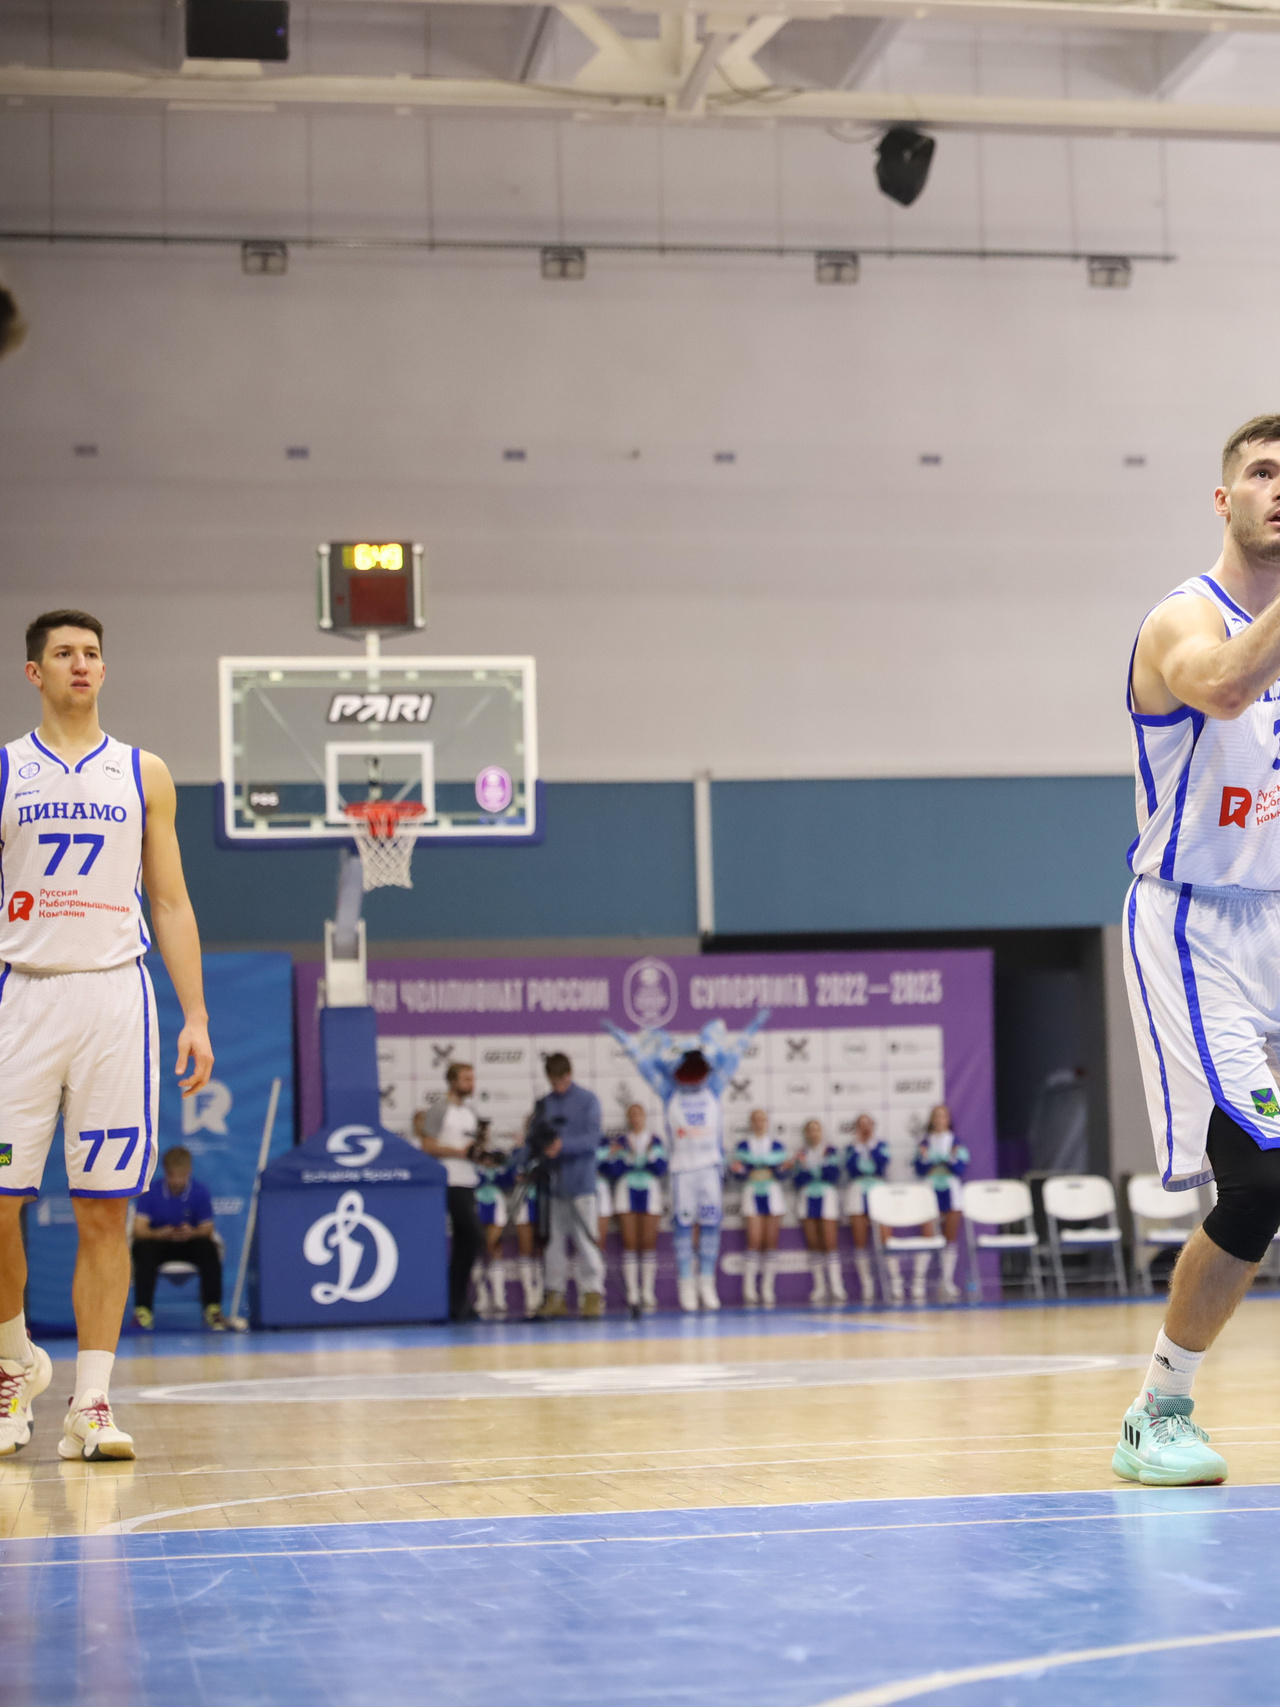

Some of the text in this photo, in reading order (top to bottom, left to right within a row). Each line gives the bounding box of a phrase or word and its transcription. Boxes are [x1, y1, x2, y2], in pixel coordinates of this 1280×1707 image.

[327, 692, 435, 723] PARI
[18, 802, 127, 827] ДИНАМО
[38, 833, 105, 876] 77
[40, 888, 78, 899] Русская
[79, 1126, 140, 1173] 77
